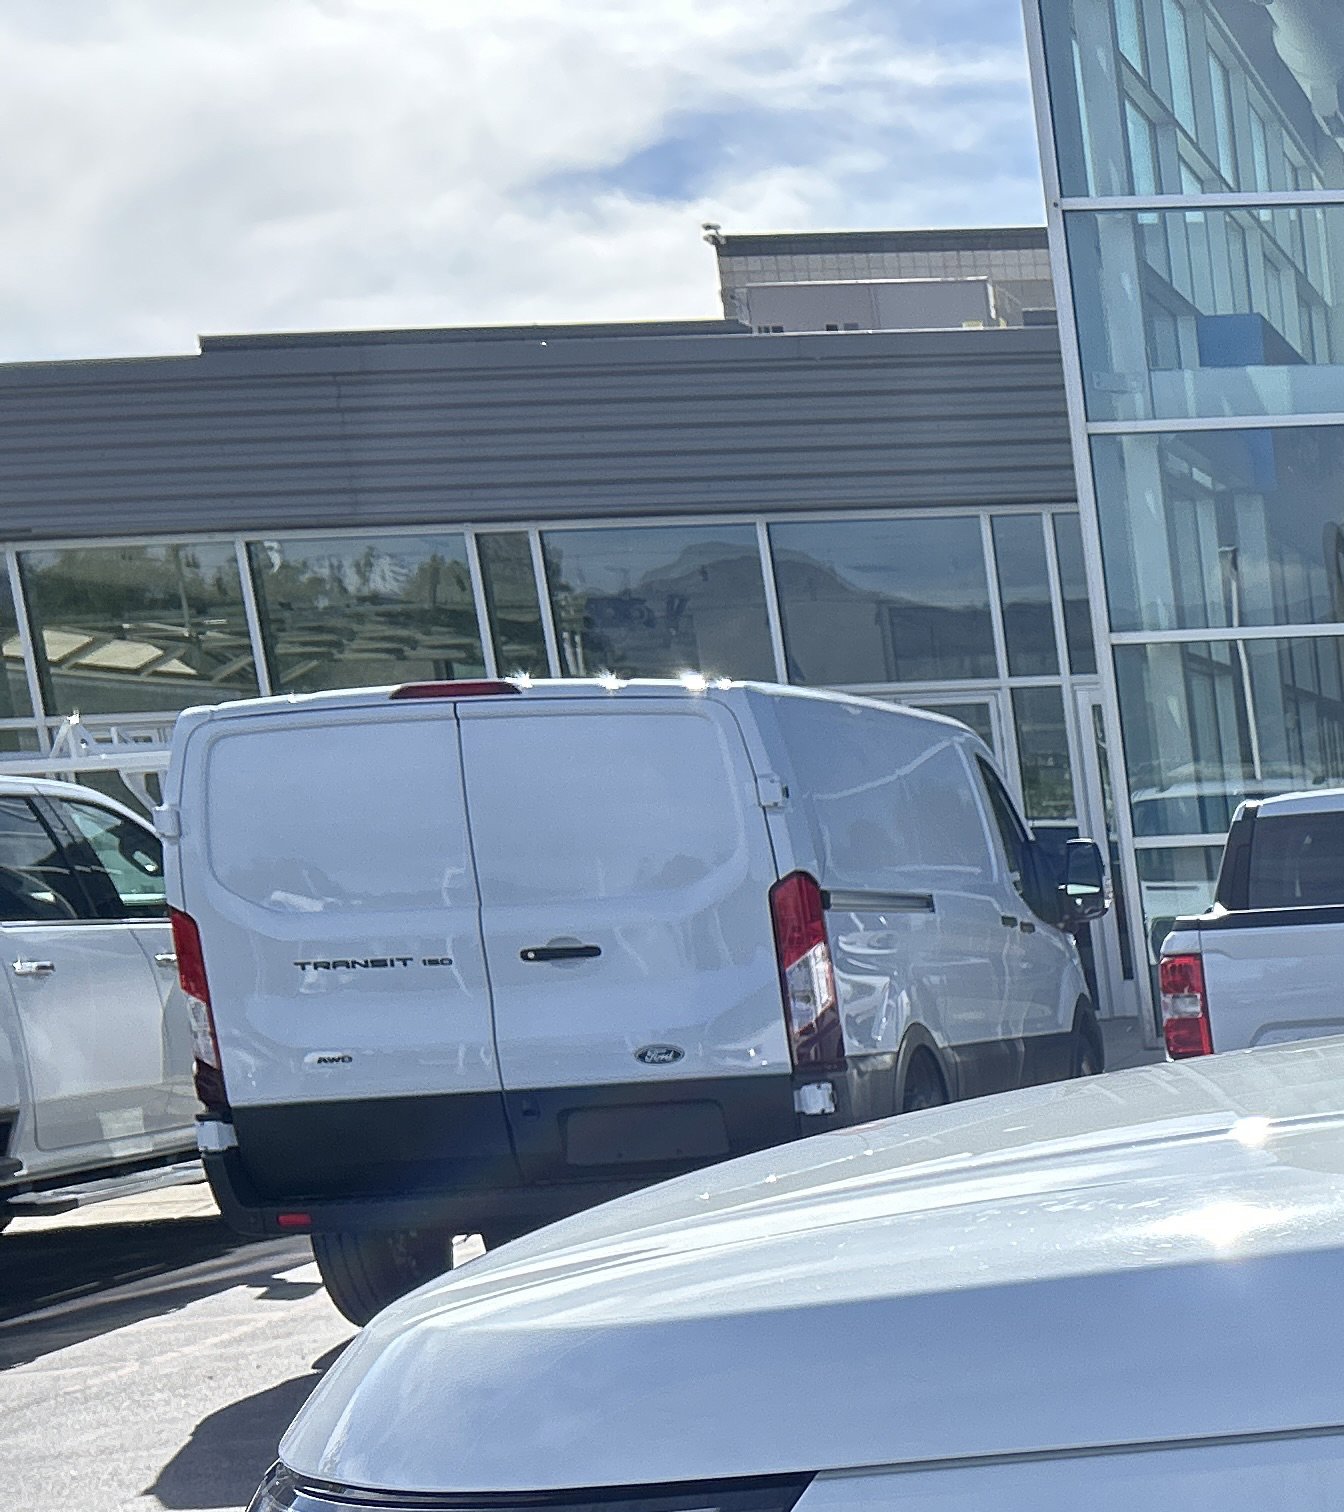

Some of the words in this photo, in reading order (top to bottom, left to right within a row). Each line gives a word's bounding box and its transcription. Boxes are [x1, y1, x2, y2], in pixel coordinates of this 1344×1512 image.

[293, 957, 414, 971] TRANSIT
[421, 958, 453, 966] 150
[317, 1054, 353, 1064] AWD
[644, 1048, 676, 1063] Ford
